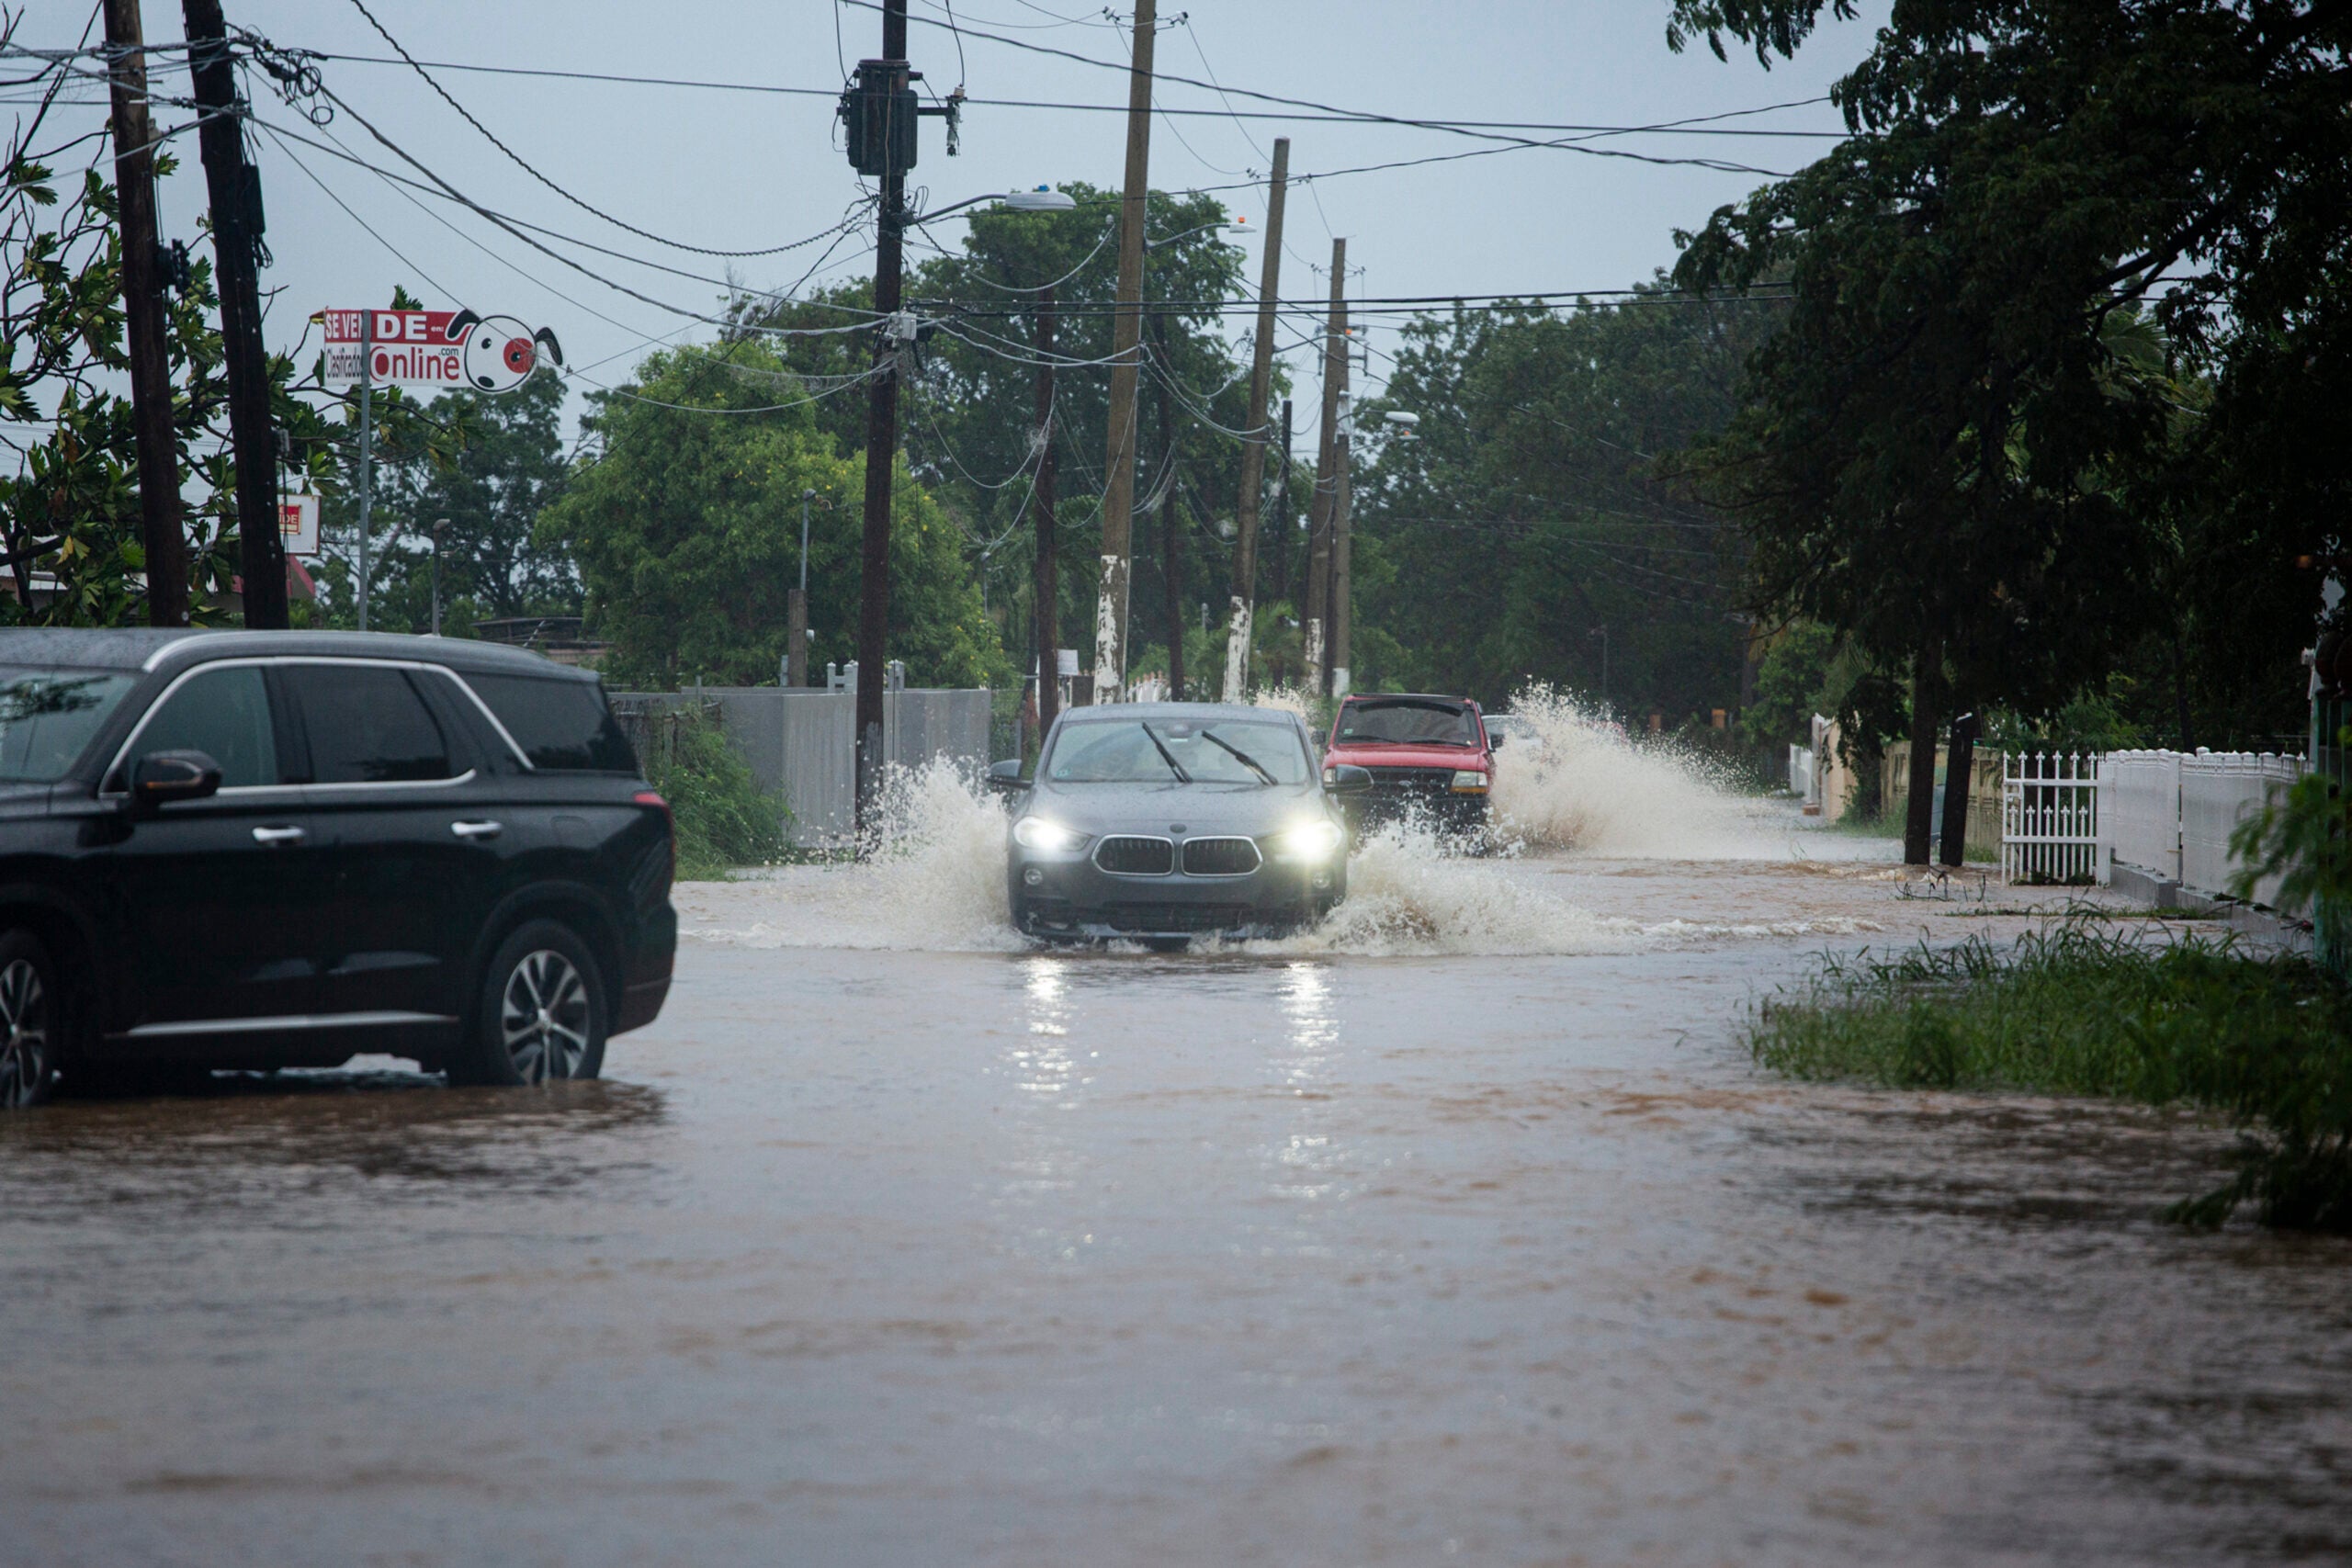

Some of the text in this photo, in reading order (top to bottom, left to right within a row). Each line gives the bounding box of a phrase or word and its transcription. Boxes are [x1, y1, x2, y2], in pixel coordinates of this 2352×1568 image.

[325, 312, 340, 339] SE
[369, 345, 459, 380] Online
[437, 347, 459, 356] .com
